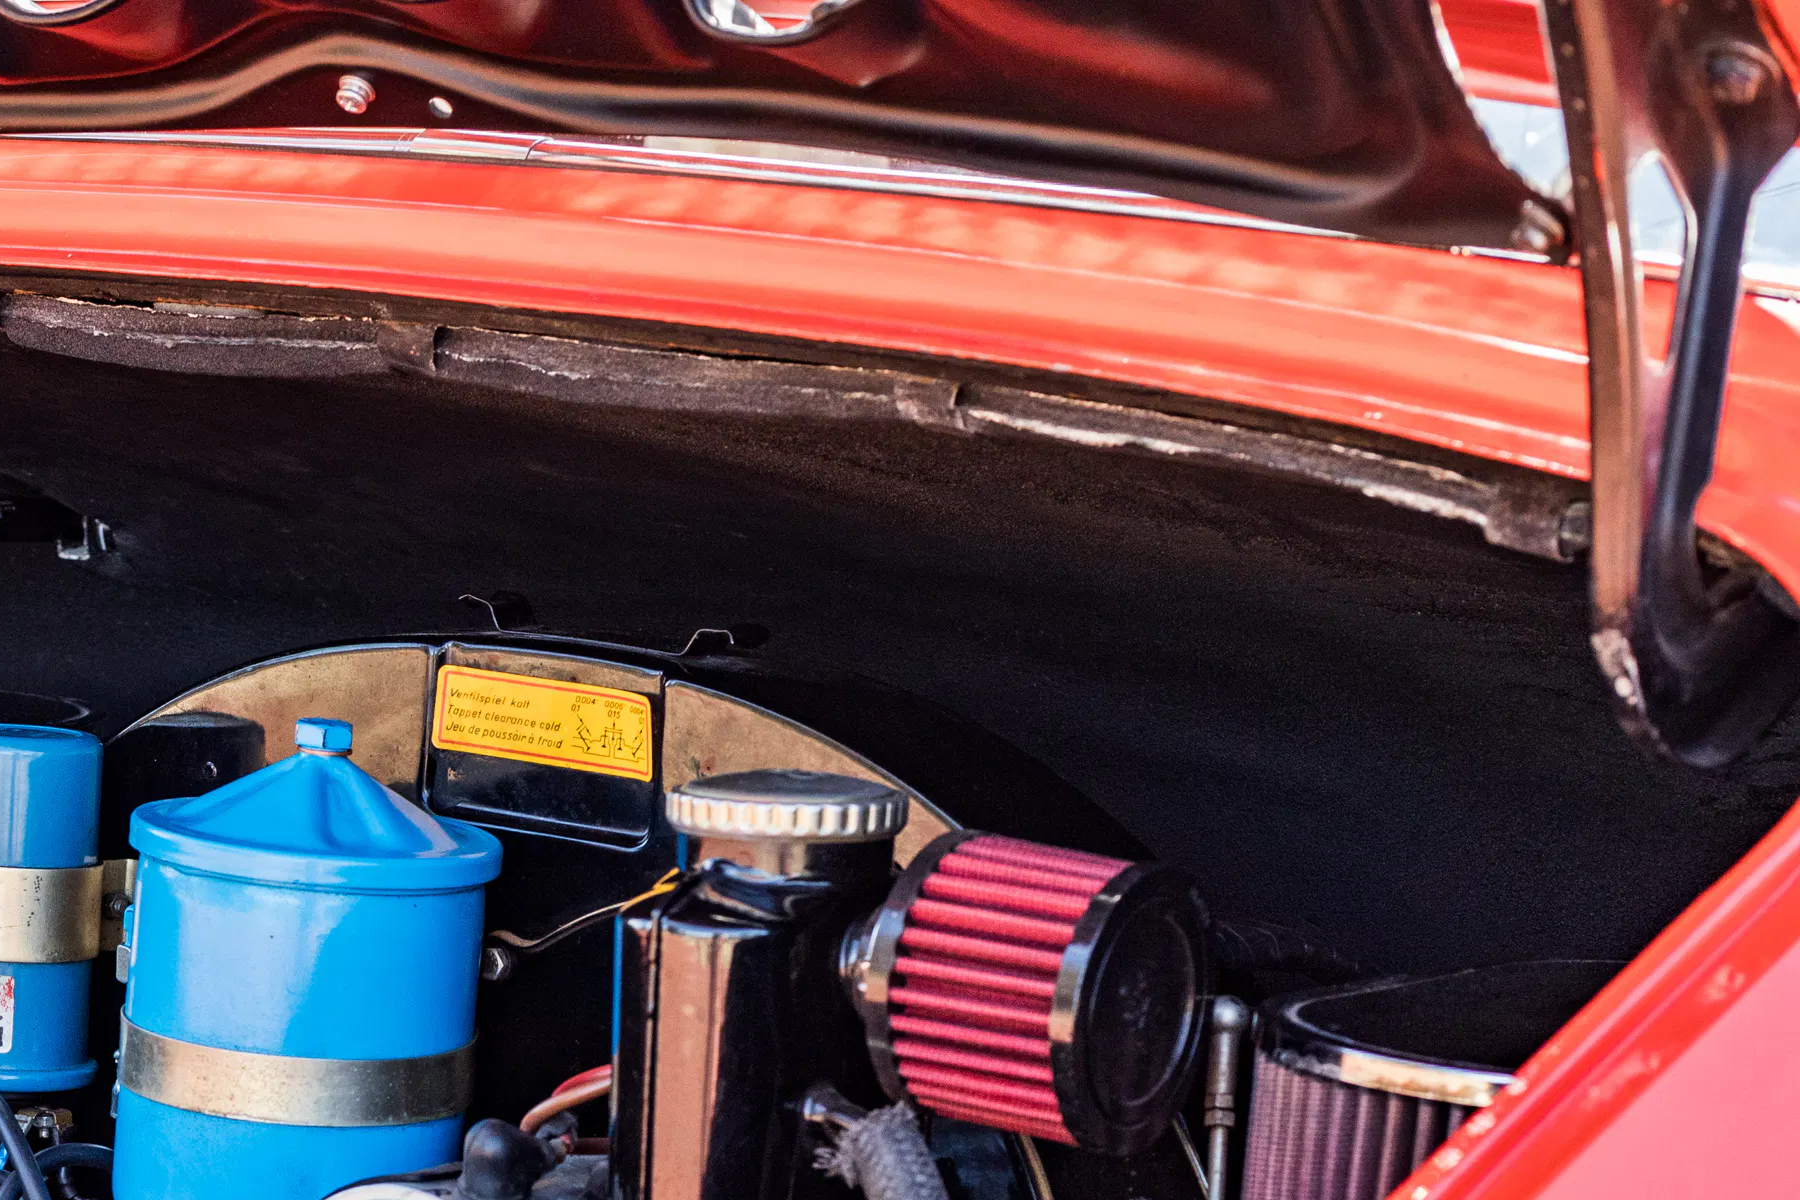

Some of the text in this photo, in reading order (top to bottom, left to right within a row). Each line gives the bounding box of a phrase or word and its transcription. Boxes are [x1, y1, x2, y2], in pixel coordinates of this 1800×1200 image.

[450, 688, 531, 709] Ventilspiel kalt
[447, 703, 562, 732] Tappet clearance cold
[445, 721, 466, 733] Jeu
[468, 724, 481, 735] de
[537, 736, 563, 749] froid
